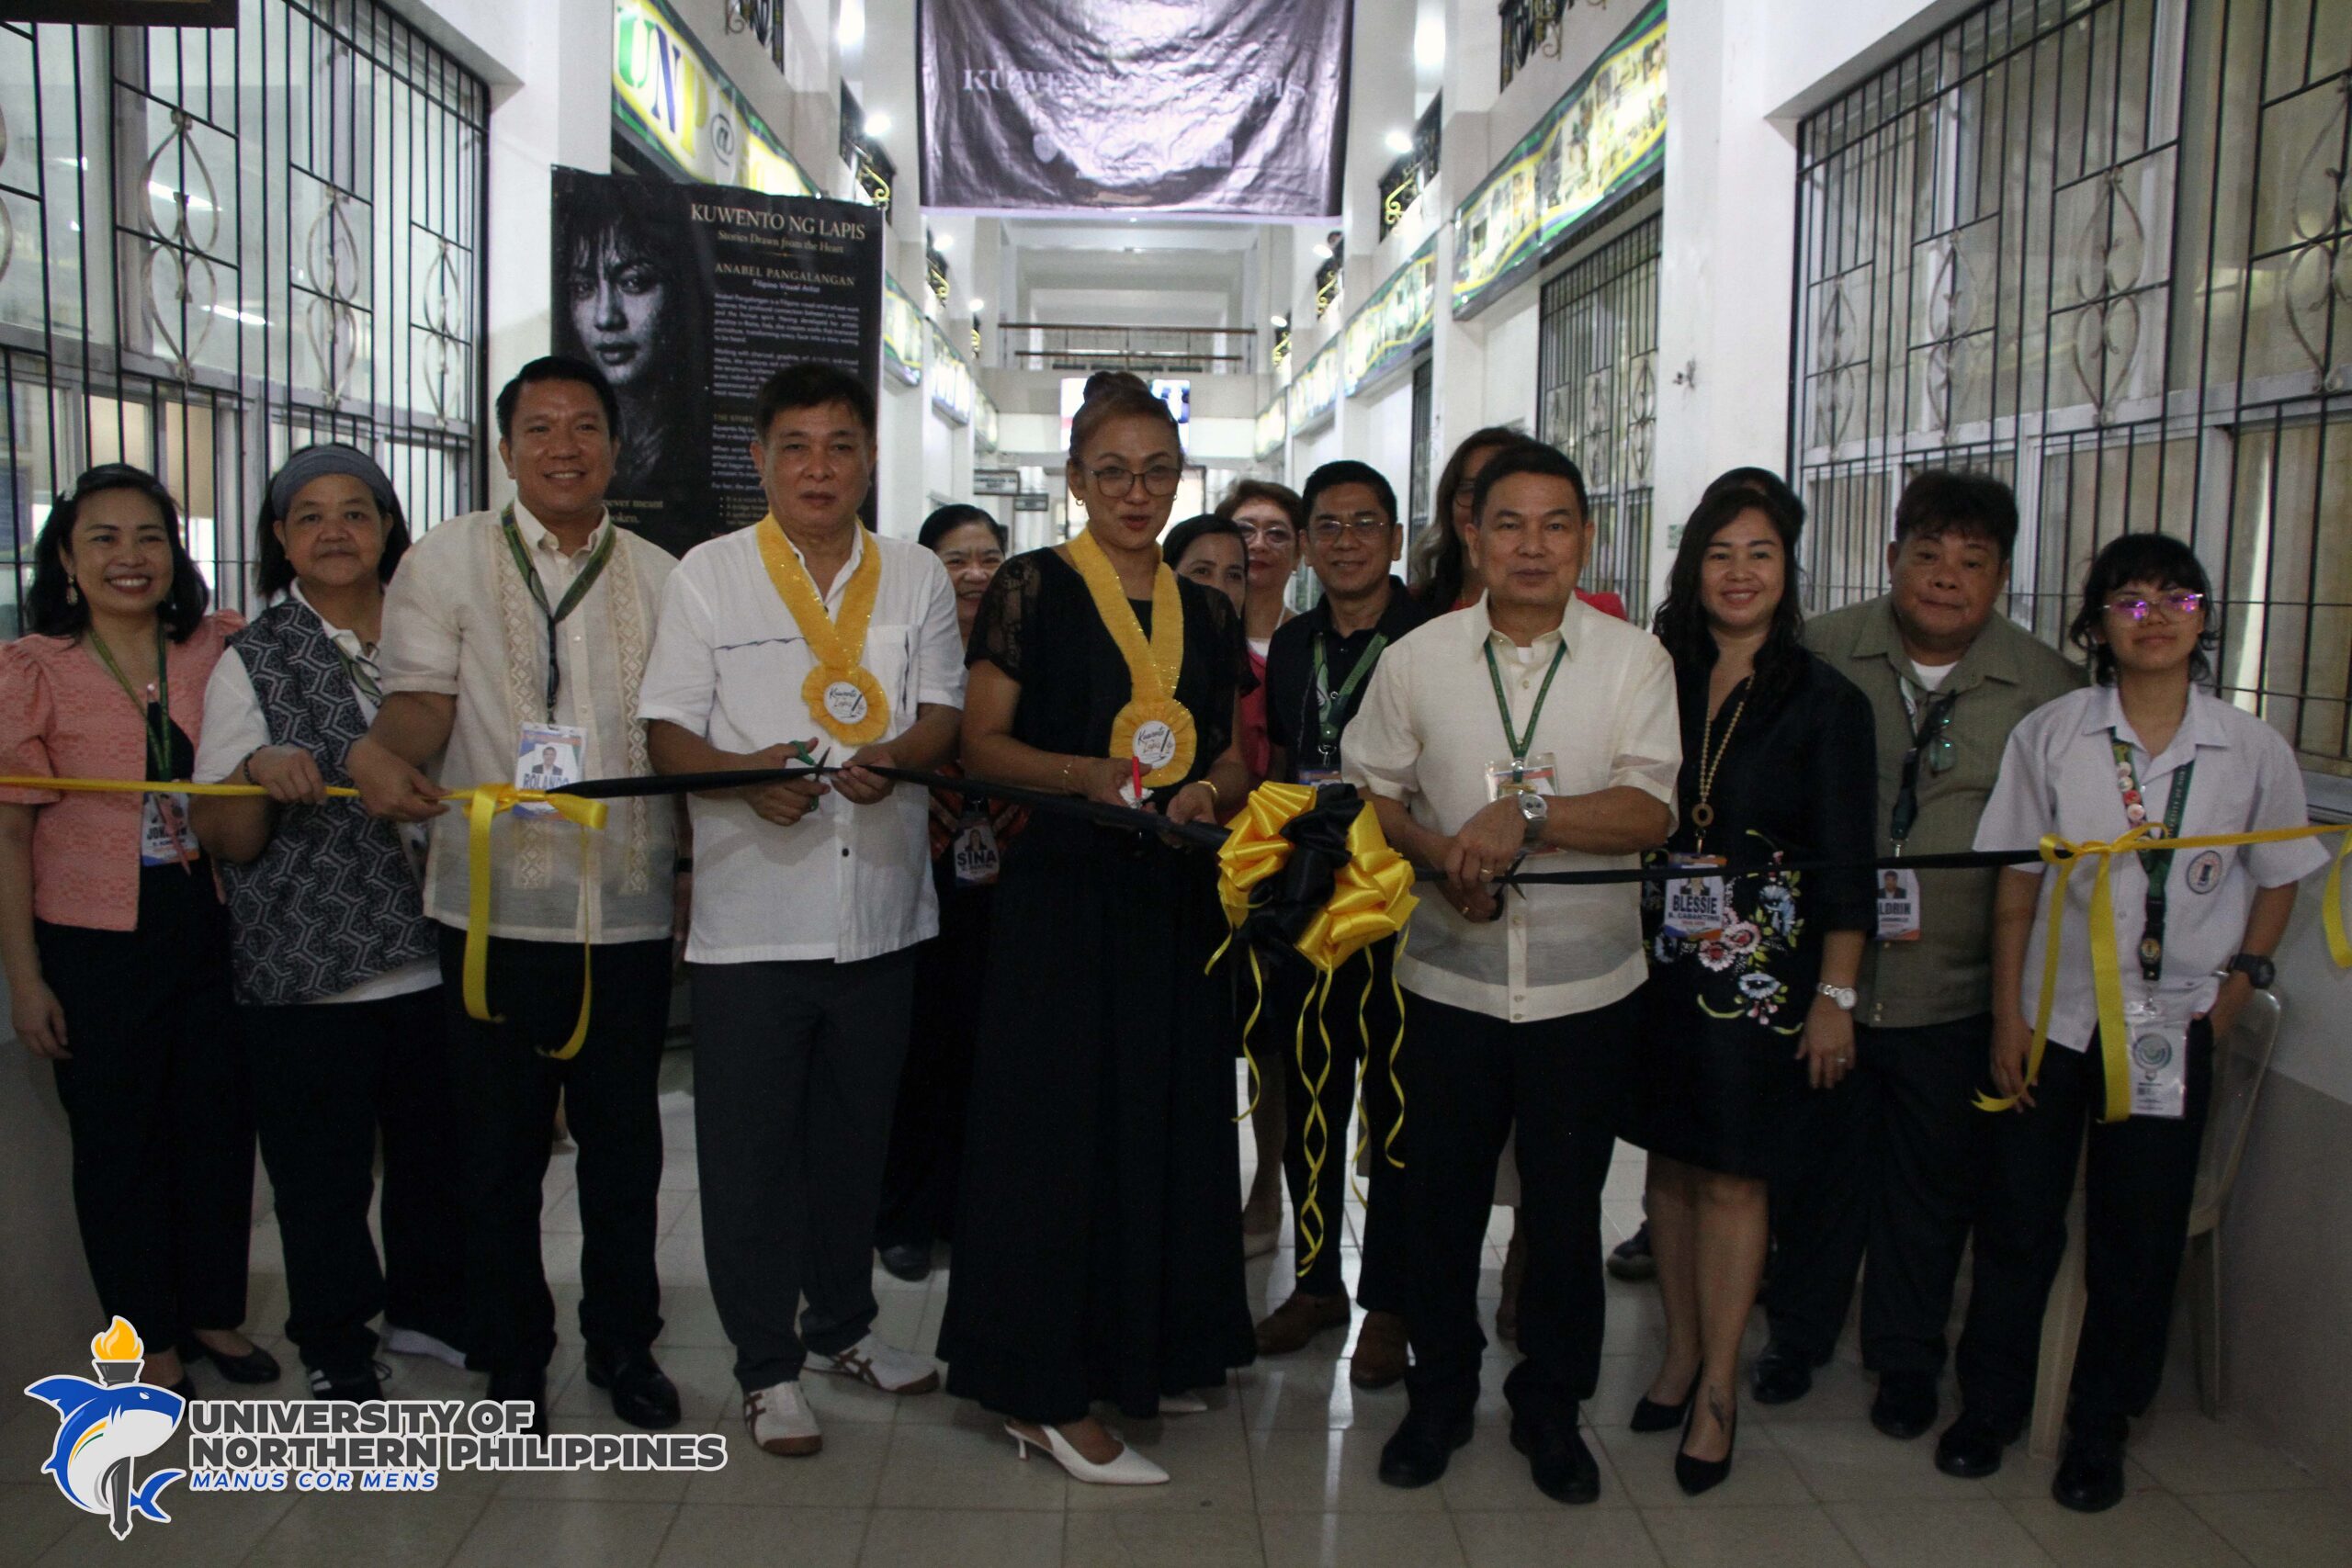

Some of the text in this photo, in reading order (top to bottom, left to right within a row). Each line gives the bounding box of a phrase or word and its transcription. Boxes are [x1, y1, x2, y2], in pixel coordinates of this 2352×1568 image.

[617, 6, 708, 158] UNP
[691, 203, 865, 241] KUWENTO NG LAPIS
[718, 231, 844, 254] Stories Drawn from the Heart
[715, 263, 855, 287] ANABEL PANGALANGAN
[956, 850, 997, 866] SINA
[1673, 894, 1717, 915] BLESSIE
